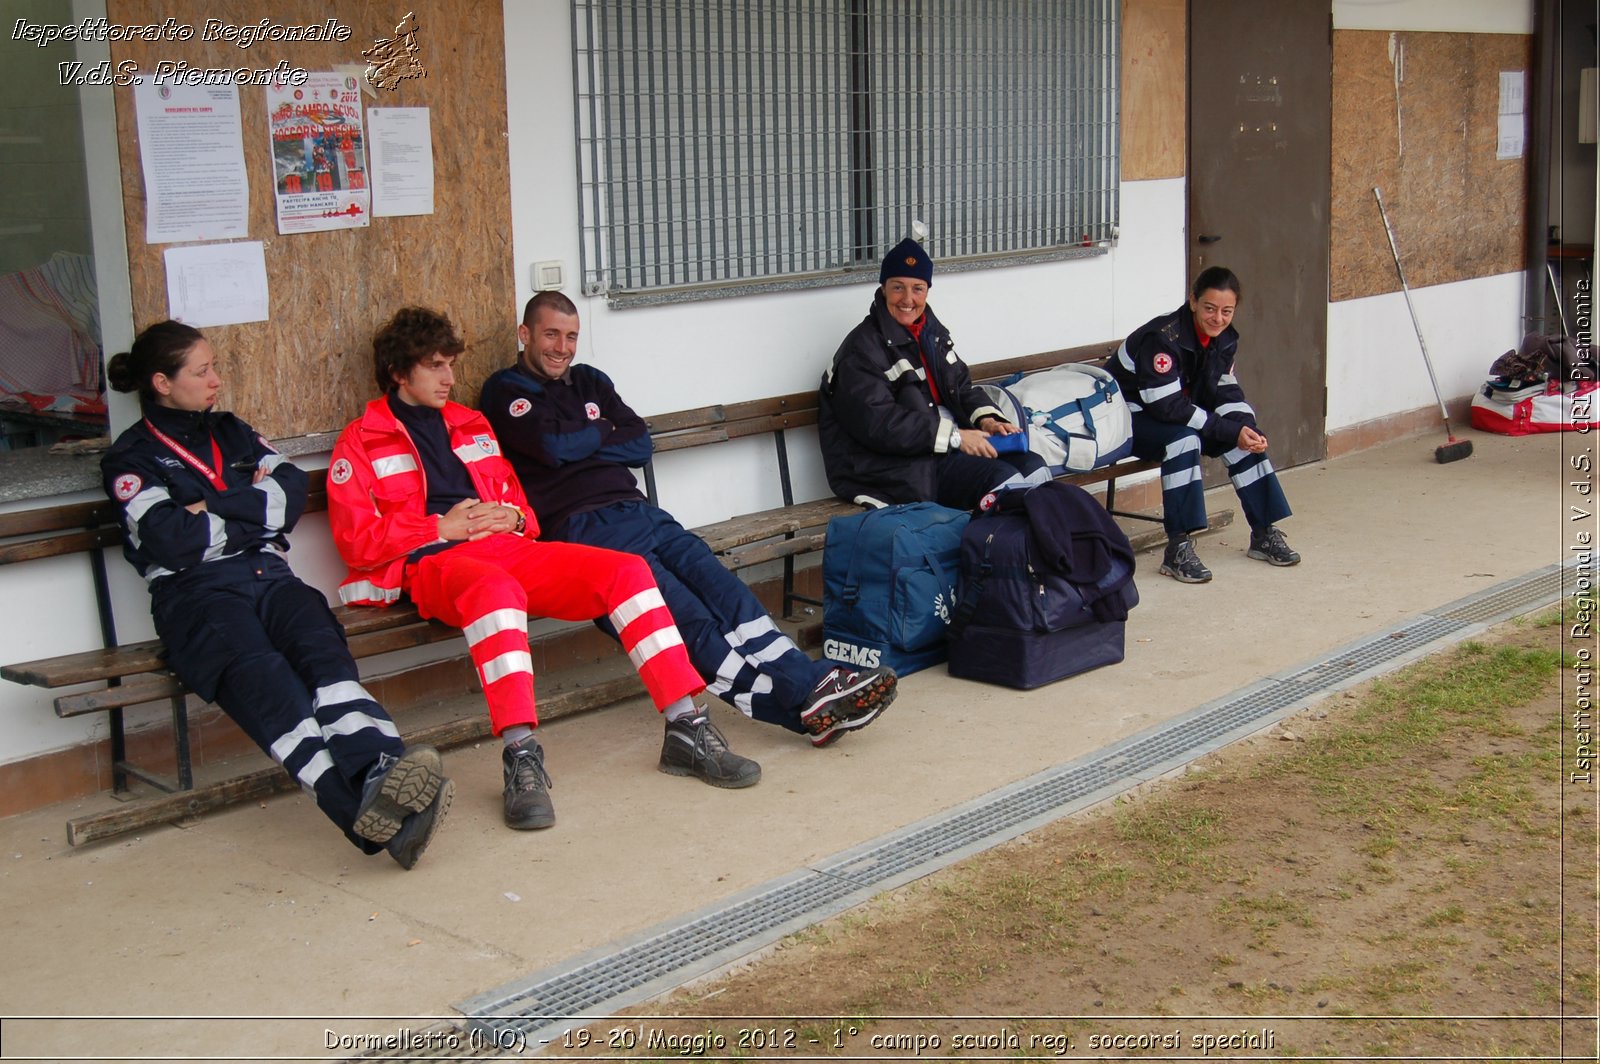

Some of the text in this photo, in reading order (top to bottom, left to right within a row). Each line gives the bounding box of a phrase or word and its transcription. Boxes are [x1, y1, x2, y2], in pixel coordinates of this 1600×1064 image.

[341, 92, 357, 102] 2012
[295, 103, 330, 118] CAMPO
[316, 172, 333, 191] 19
[824, 639, 881, 669] GEMS
